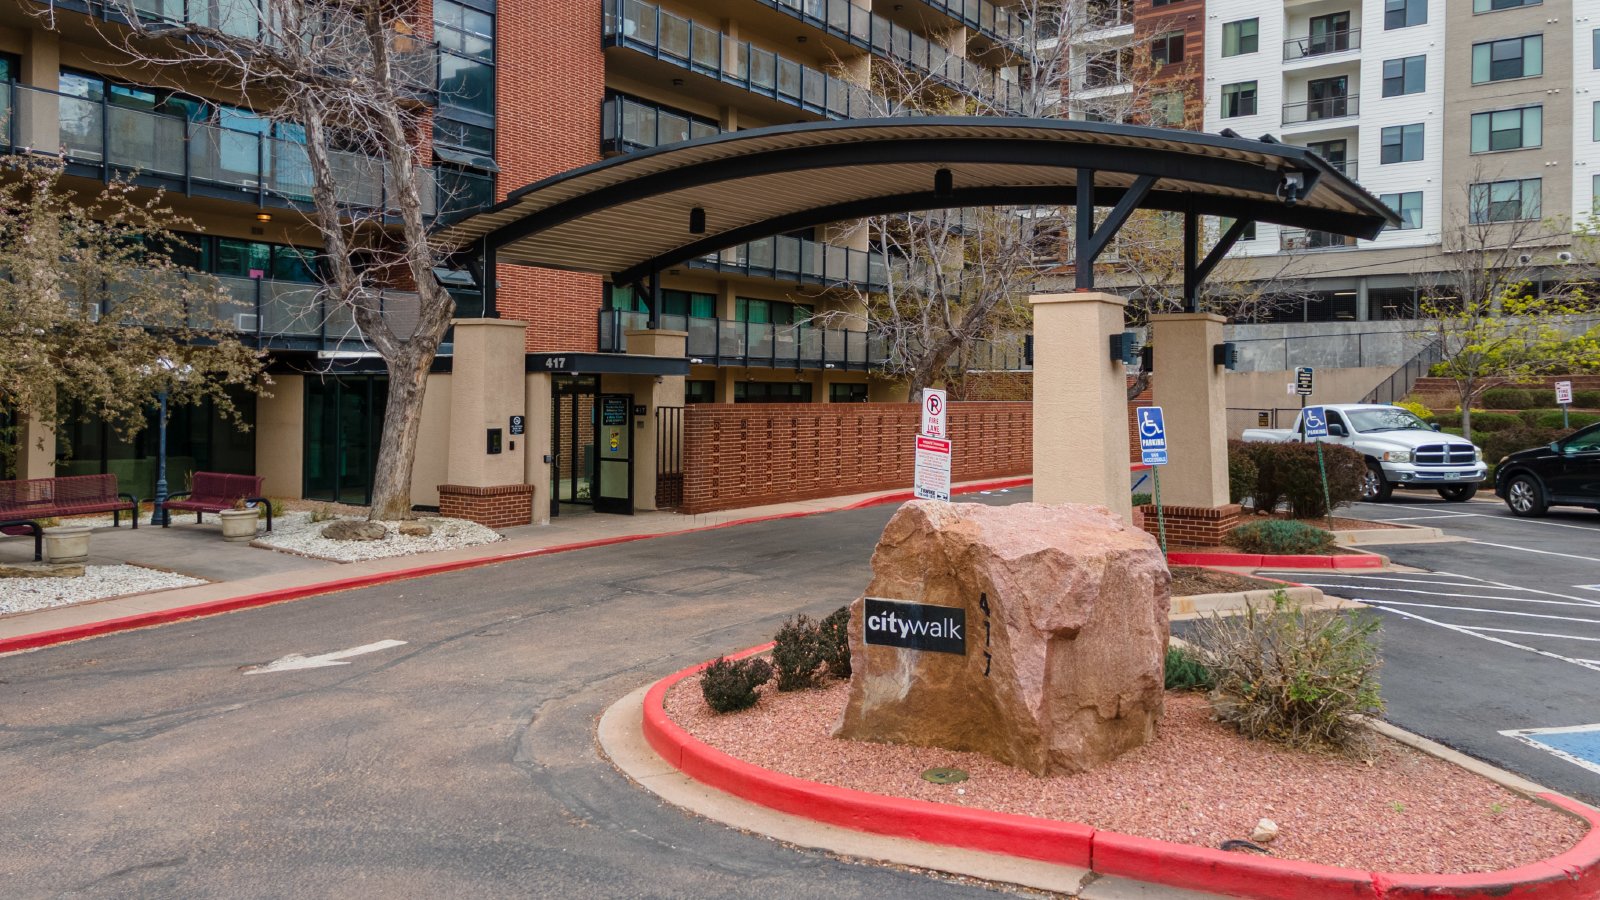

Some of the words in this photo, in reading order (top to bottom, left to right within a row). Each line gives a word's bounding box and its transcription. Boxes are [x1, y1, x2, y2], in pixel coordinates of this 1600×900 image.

[545, 357, 566, 369] 417
[1142, 438, 1164, 446] PARKING
[868, 610, 962, 640] citywalk
[979, 592, 992, 677] 417
